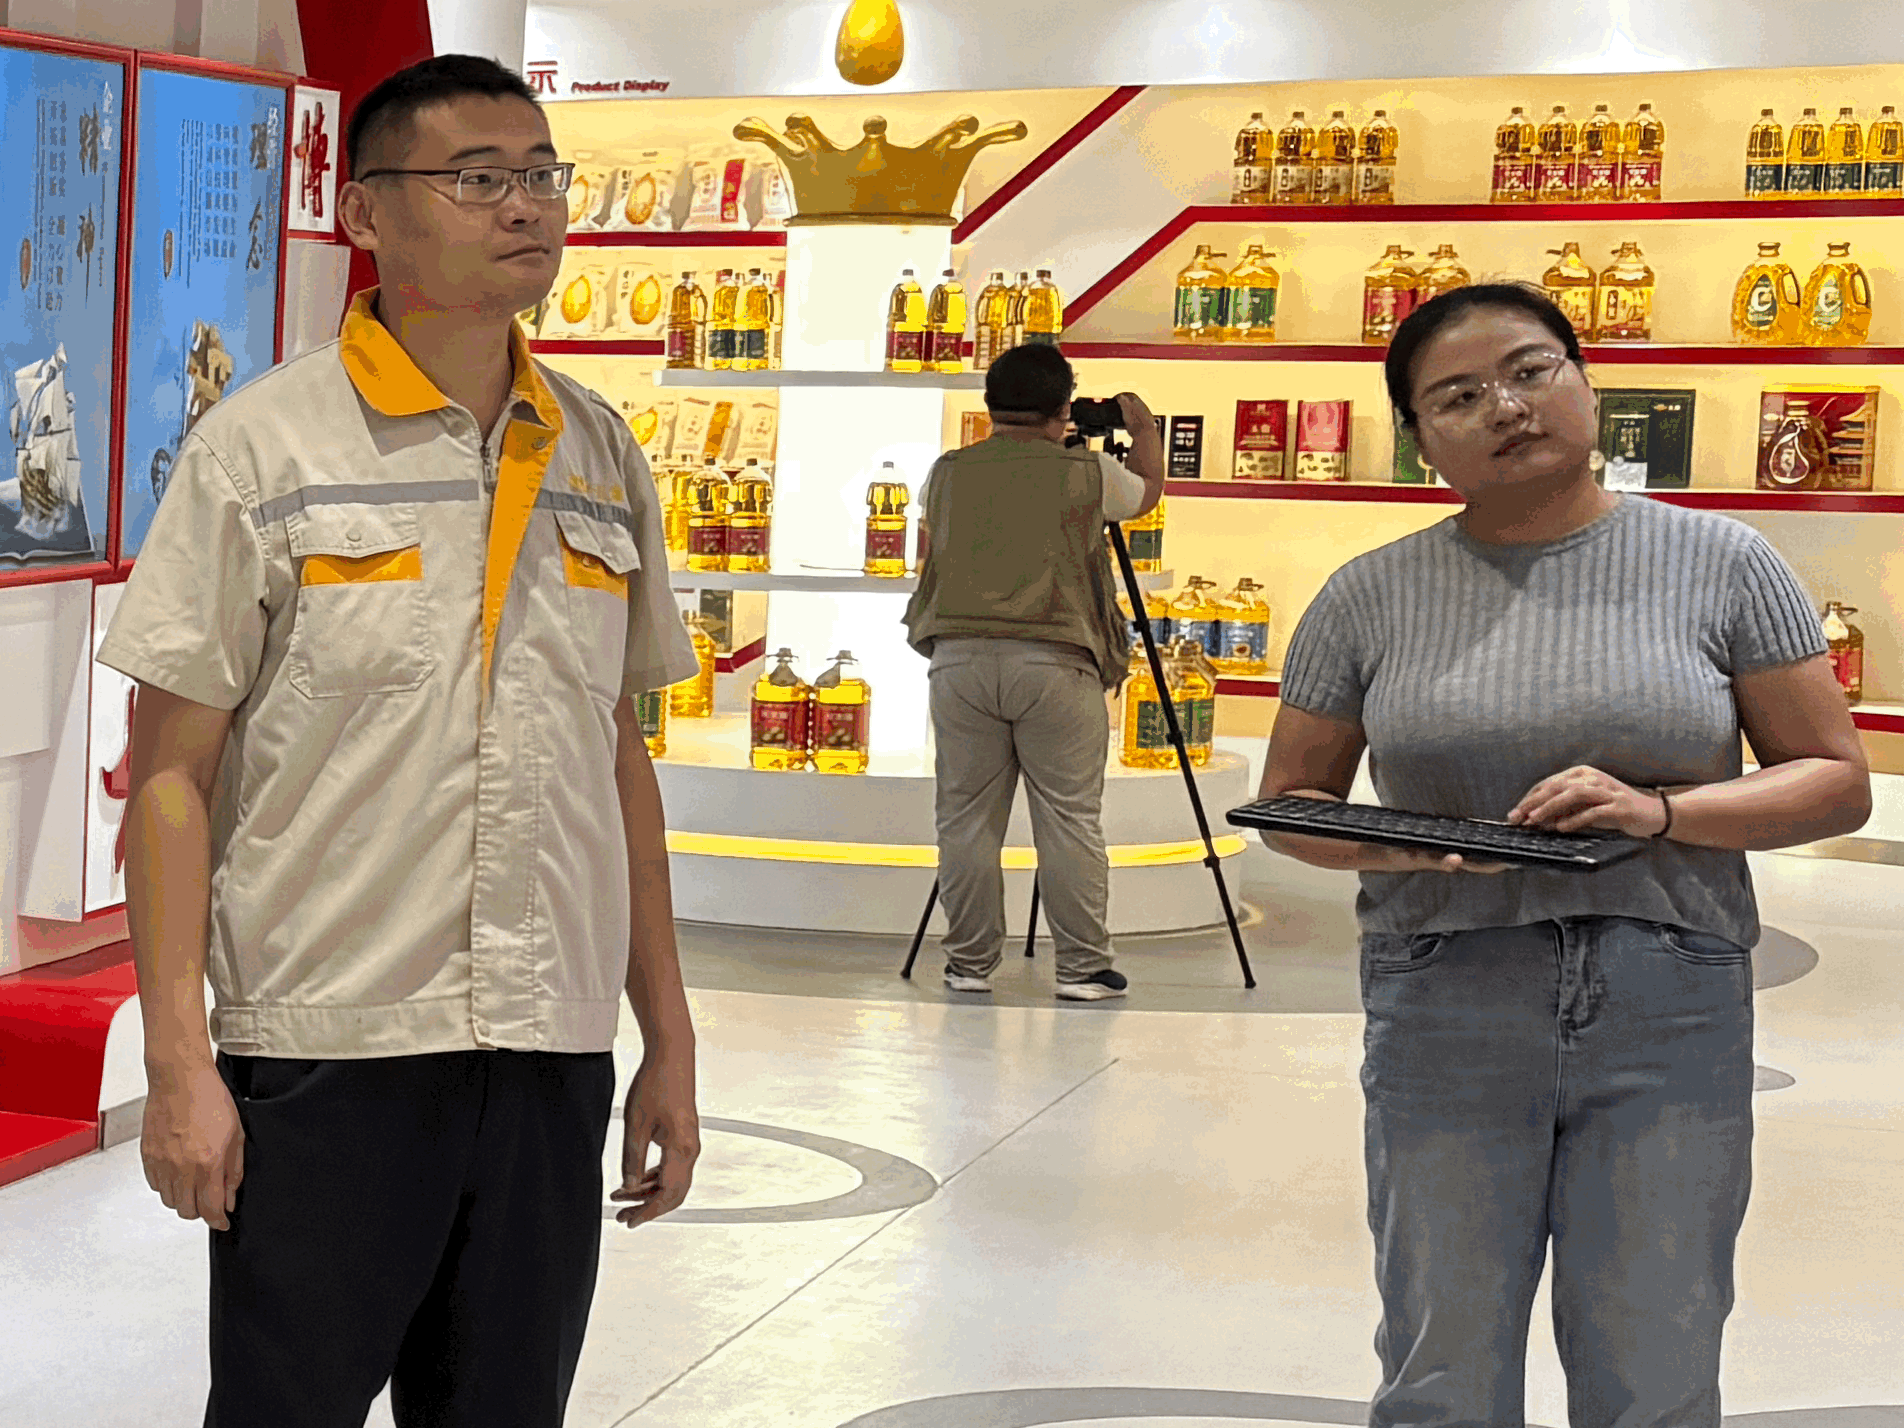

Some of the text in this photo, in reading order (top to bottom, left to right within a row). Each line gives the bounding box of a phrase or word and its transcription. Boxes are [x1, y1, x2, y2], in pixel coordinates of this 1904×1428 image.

[527, 61, 558, 93] 示
[571, 80, 670, 93] Product Display
